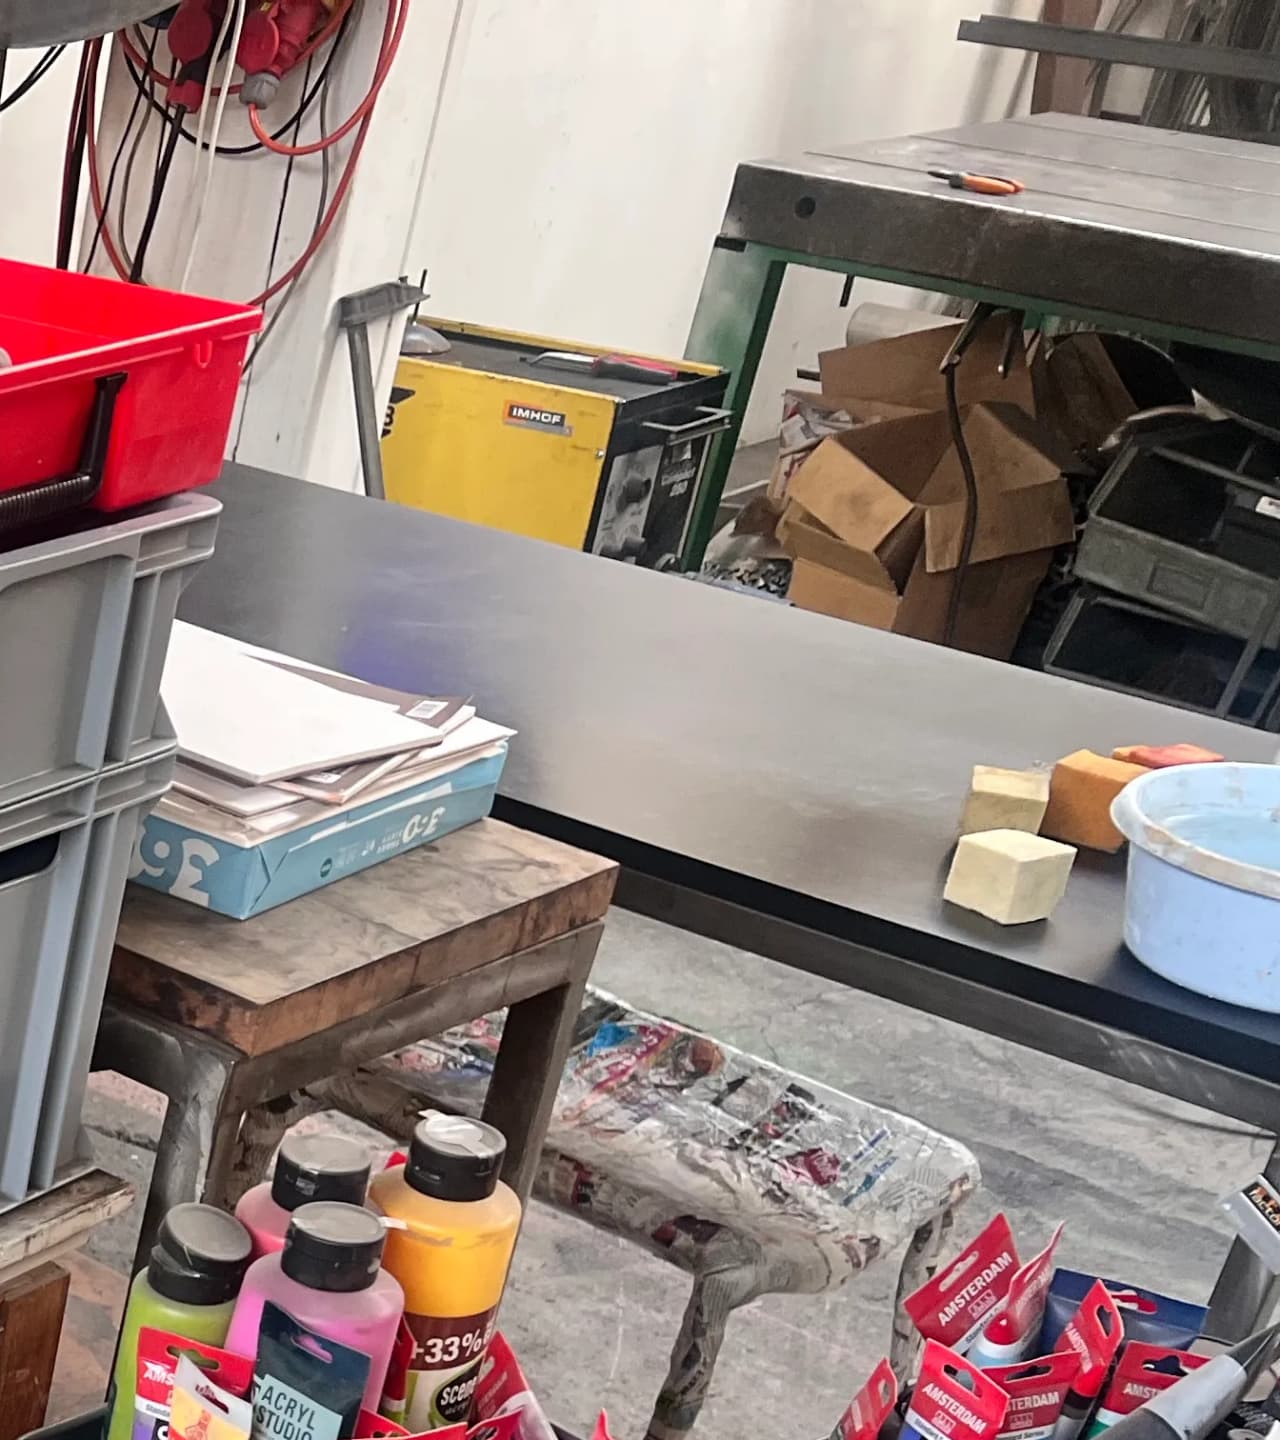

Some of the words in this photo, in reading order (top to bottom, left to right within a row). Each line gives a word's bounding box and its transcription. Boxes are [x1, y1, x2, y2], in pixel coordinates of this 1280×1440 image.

[512, 407, 562, 425] IMHOF
[938, 1251, 1013, 1327] AMSTERDAM
[261, 1385, 315, 1431] ACRYL
[921, 1382, 987, 1435] AMSTERDAM
